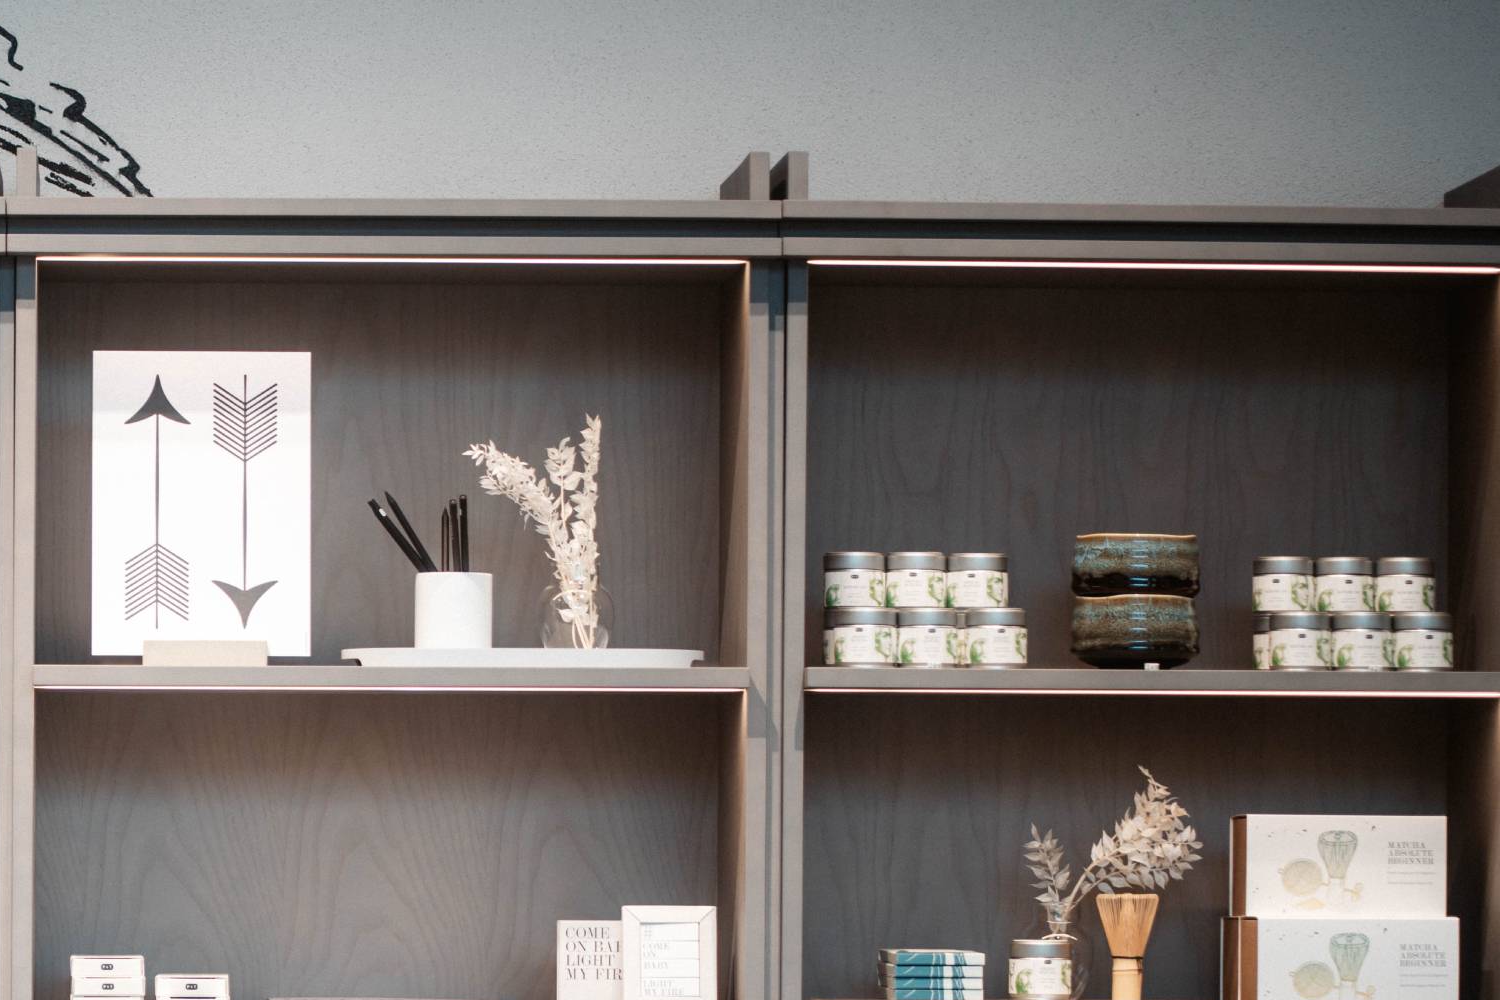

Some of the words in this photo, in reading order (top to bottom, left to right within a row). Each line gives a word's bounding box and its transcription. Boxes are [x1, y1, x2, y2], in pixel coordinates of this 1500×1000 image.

[566, 927, 609, 939] COME
[566, 941, 587, 952] ON
[594, 941, 620, 952] BA
[566, 954, 615, 966] LIGHT
[566, 968, 587, 980] MY
[596, 968, 622, 980] FIR
